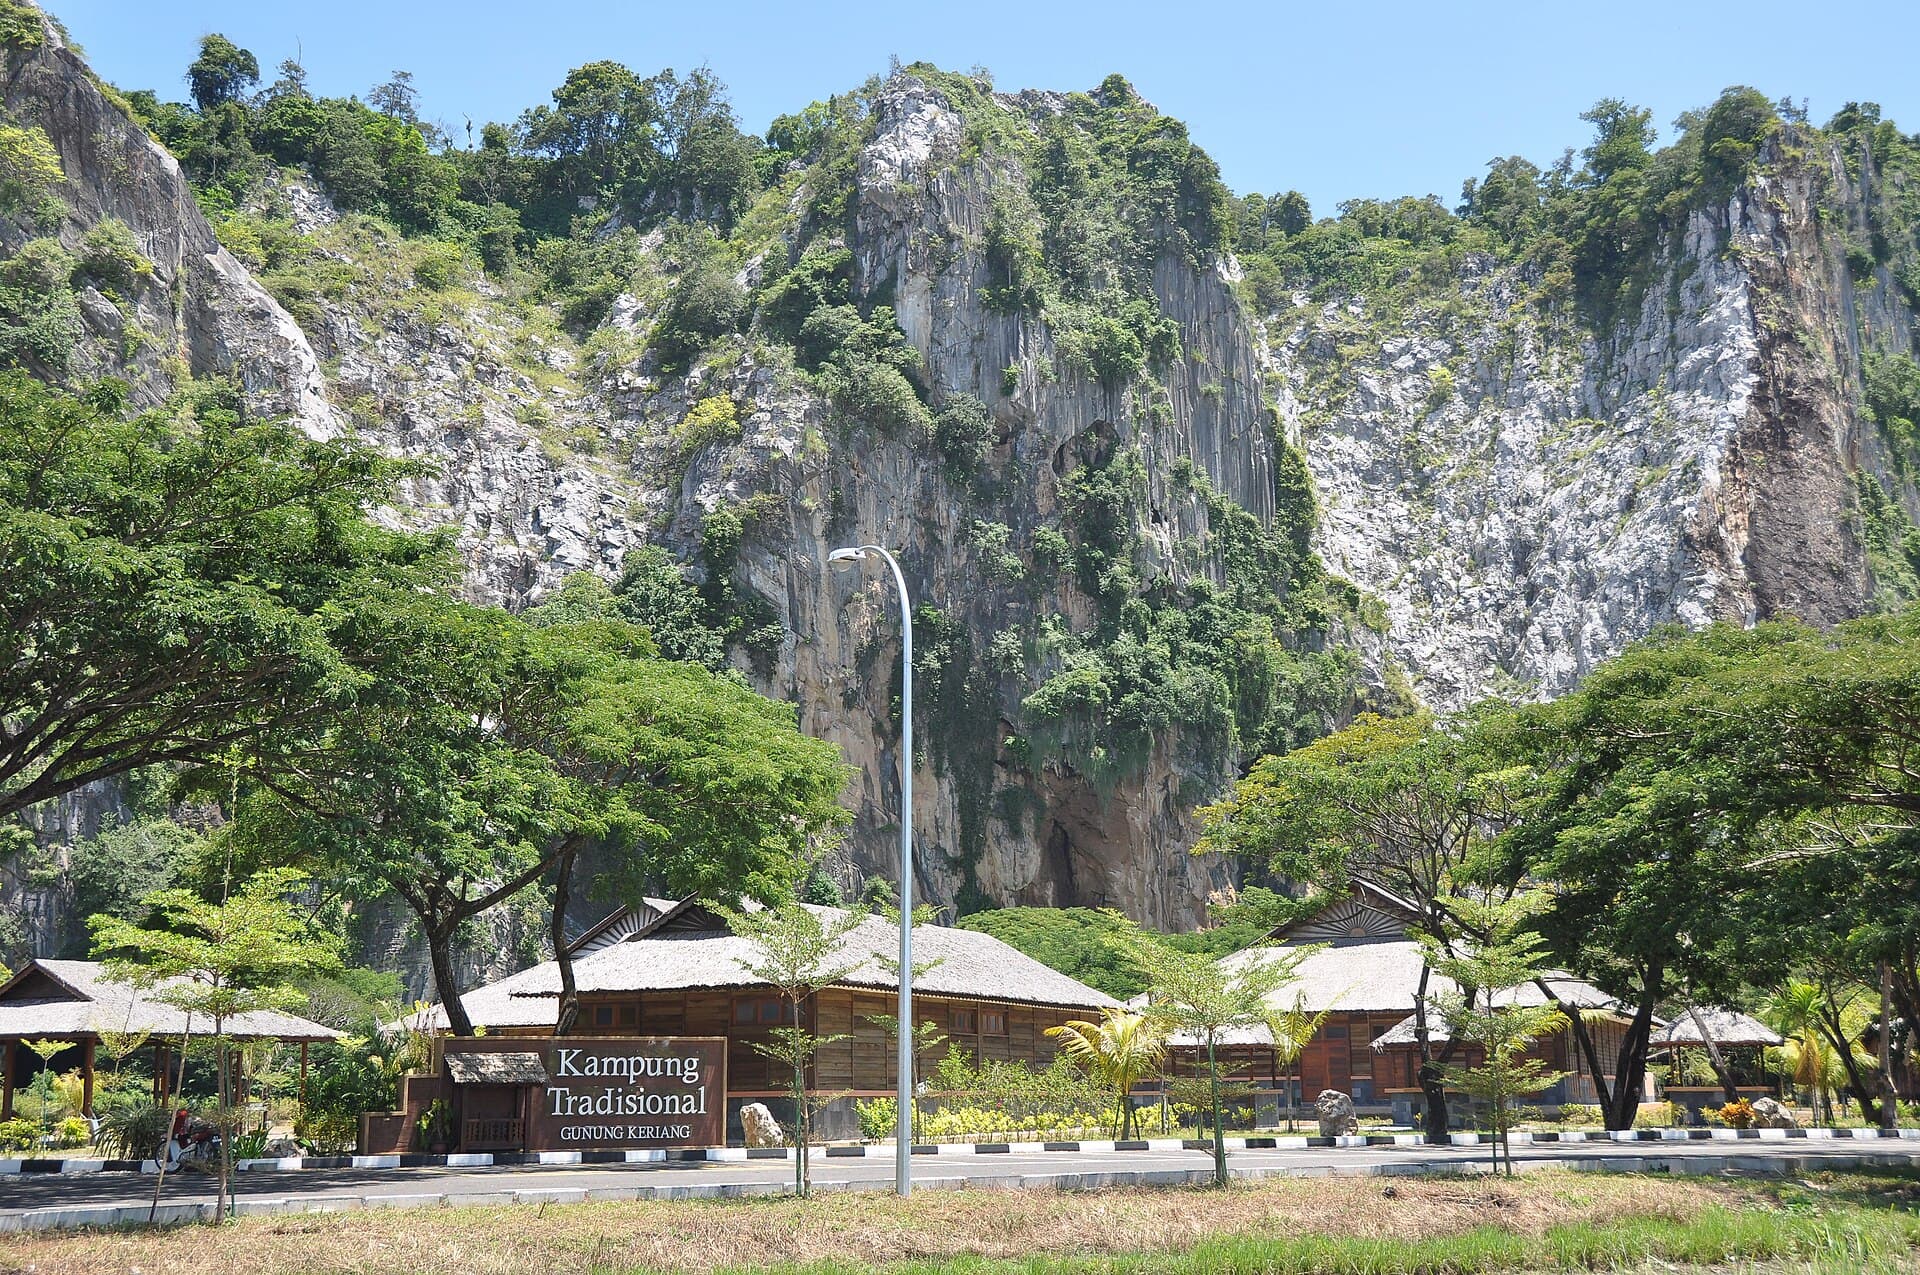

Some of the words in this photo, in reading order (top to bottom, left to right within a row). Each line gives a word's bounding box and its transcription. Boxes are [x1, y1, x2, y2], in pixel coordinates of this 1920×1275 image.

[557, 1049, 699, 1083] Kampung
[547, 1087, 707, 1116] Tradisional
[560, 1125, 624, 1140] GUNUNG
[627, 1125, 691, 1139] KERIANG
